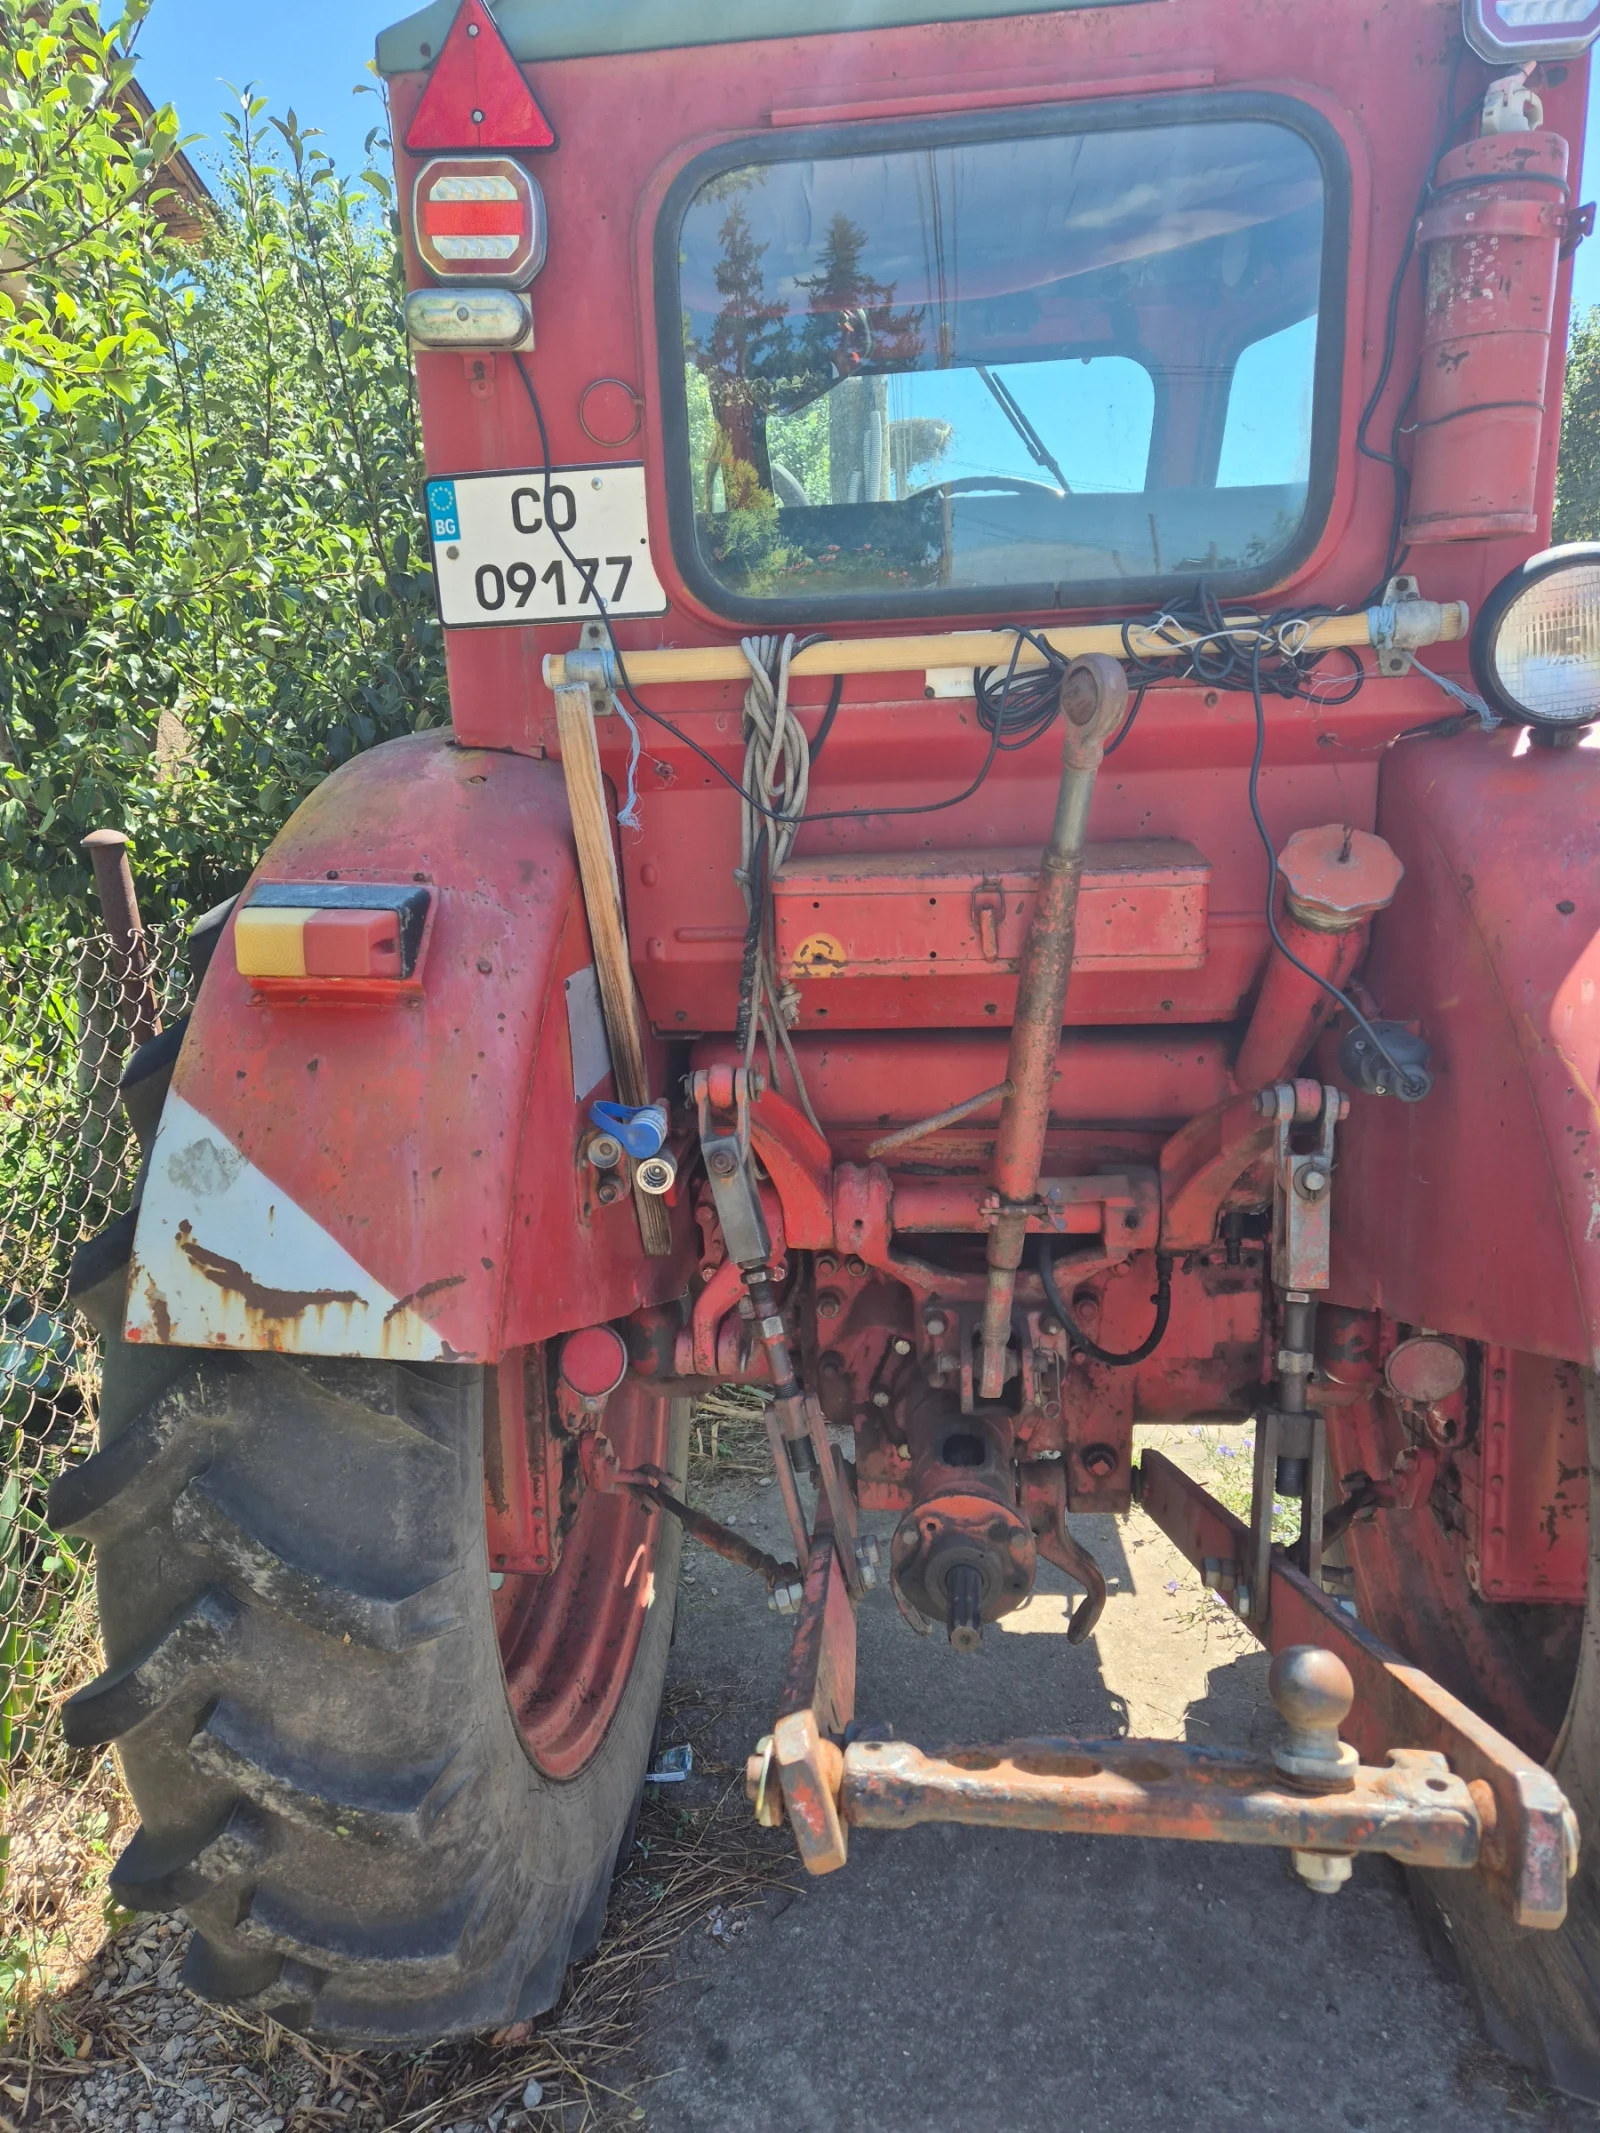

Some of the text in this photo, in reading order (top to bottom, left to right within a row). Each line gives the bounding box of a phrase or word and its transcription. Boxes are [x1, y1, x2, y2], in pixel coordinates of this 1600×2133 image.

[435, 519, 456, 535] BG
[511, 485, 576, 534] CO
[475, 556, 632, 610] 09177
